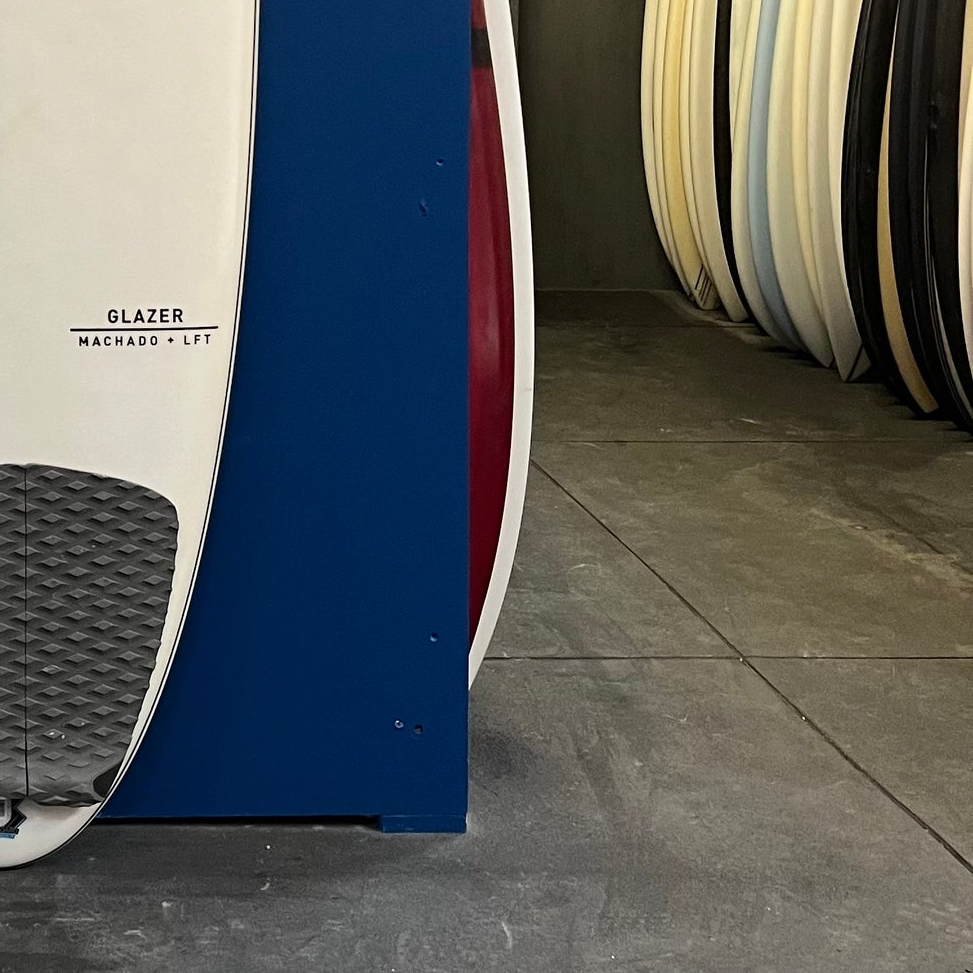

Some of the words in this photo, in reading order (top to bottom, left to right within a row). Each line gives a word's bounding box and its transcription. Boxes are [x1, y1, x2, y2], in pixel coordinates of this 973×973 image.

[107, 308, 183, 323] GLAZER
[78, 335, 158, 347] MACHADO
[183, 333, 211, 346] LFT
